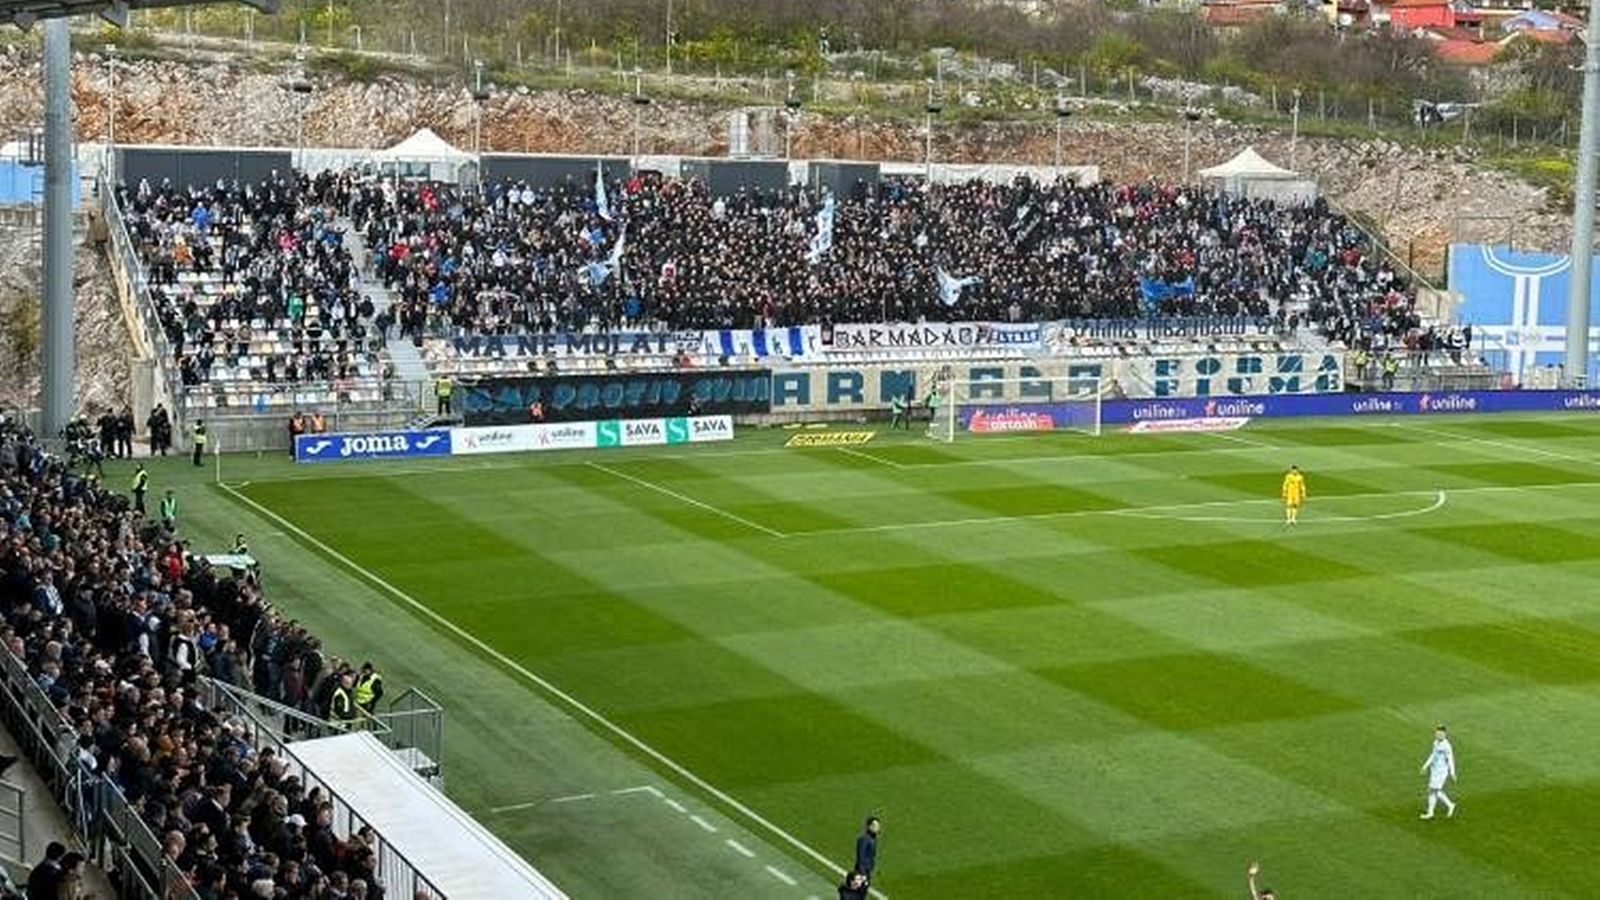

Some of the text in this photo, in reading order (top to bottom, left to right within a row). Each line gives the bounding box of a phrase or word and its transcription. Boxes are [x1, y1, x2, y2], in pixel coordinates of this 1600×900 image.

[453, 334, 505, 357] MA
[518, 334, 557, 354] NE
[1217, 399, 1265, 416] uniline
[1432, 395, 1476, 410] uniline
[626, 423, 660, 436] SAVA
[693, 420, 727, 433] SAVA
